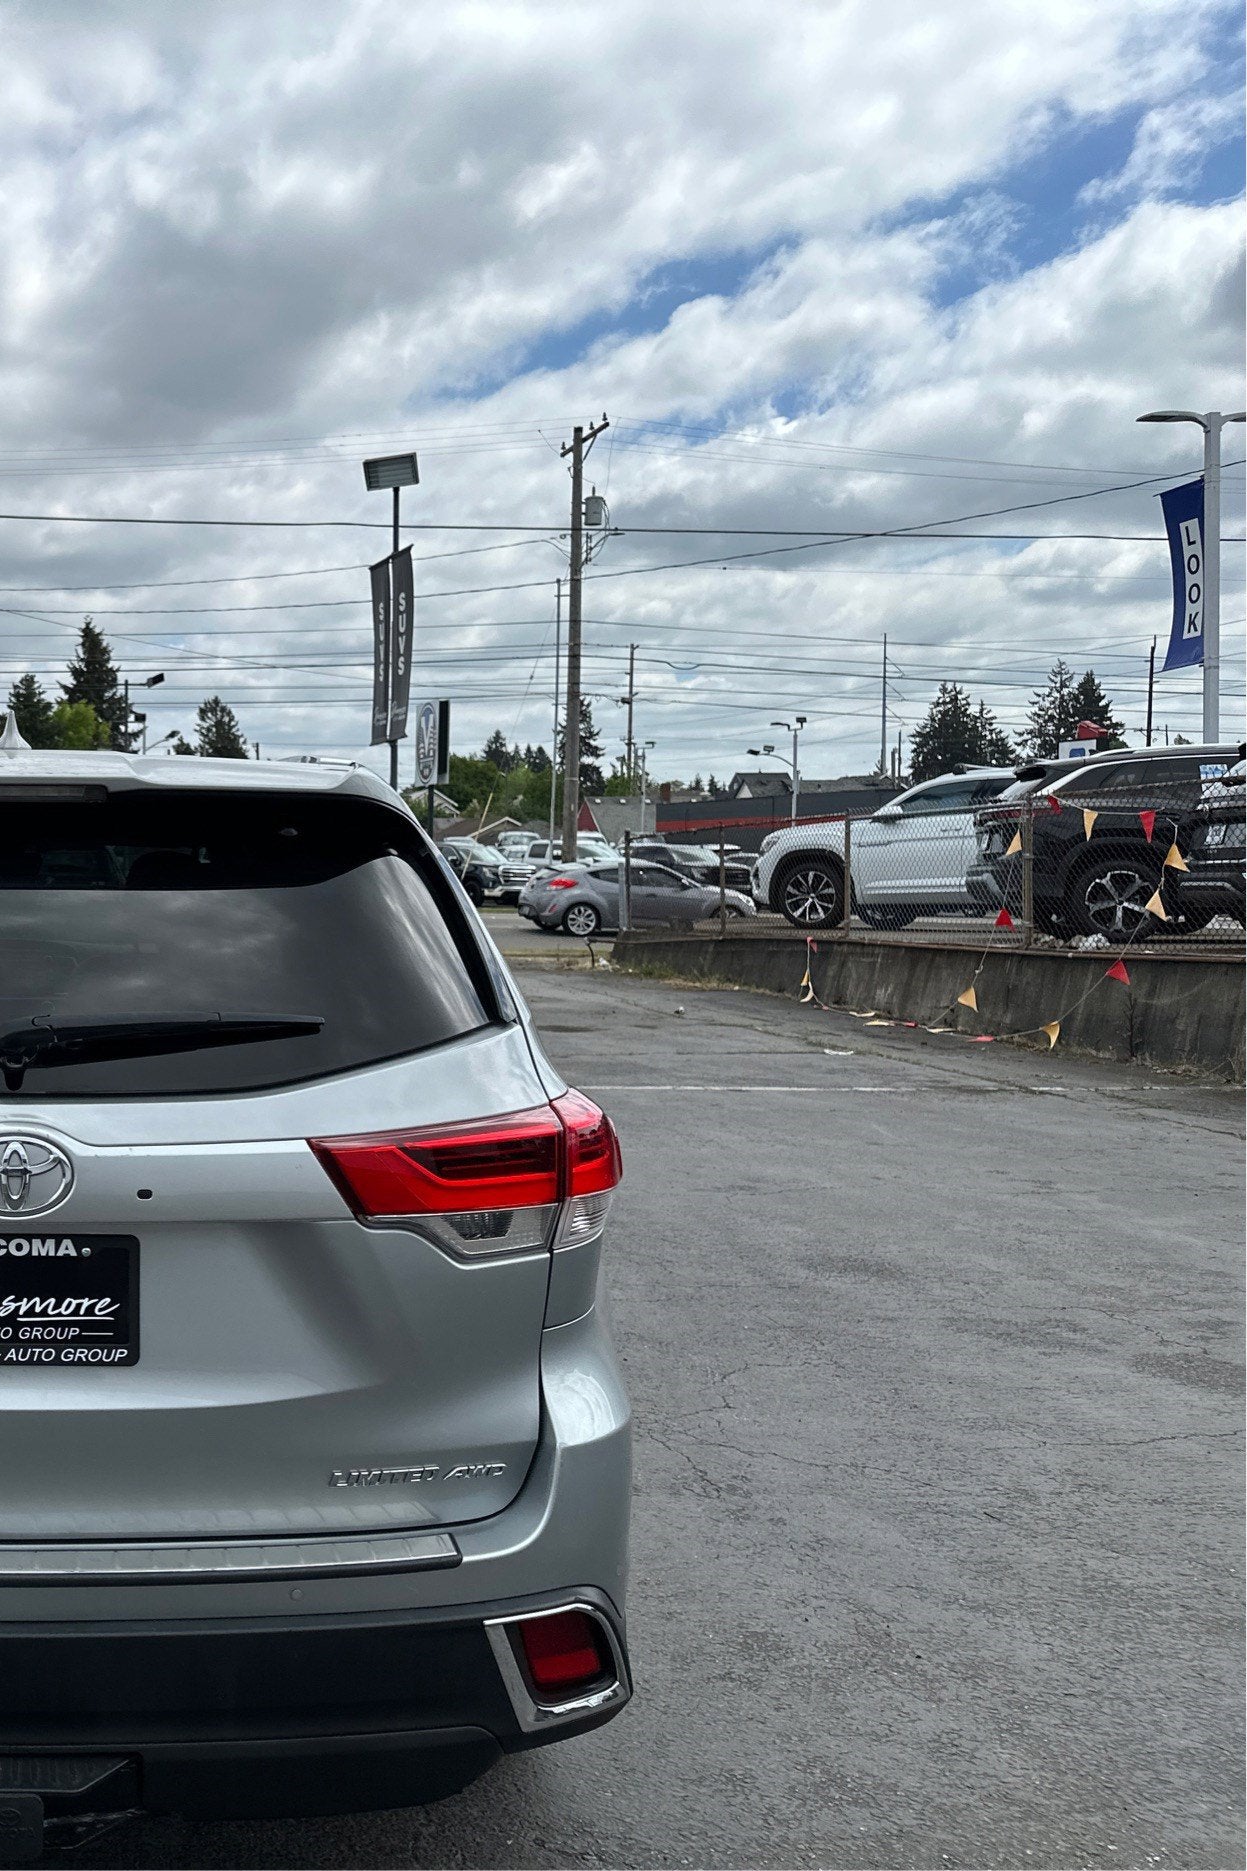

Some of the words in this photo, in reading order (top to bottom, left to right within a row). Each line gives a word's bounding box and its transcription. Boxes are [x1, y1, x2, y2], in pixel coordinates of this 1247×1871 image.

[1185, 525, 1201, 634] LOOK
[397, 592, 407, 676] SUVS
[18, 1327, 80, 1340] GROUP
[4, 1348, 55, 1362] AUTO
[60, 1348, 128, 1362] GROUP
[328, 1465, 440, 1488] LIMITED
[443, 1463, 507, 1481] AWD
